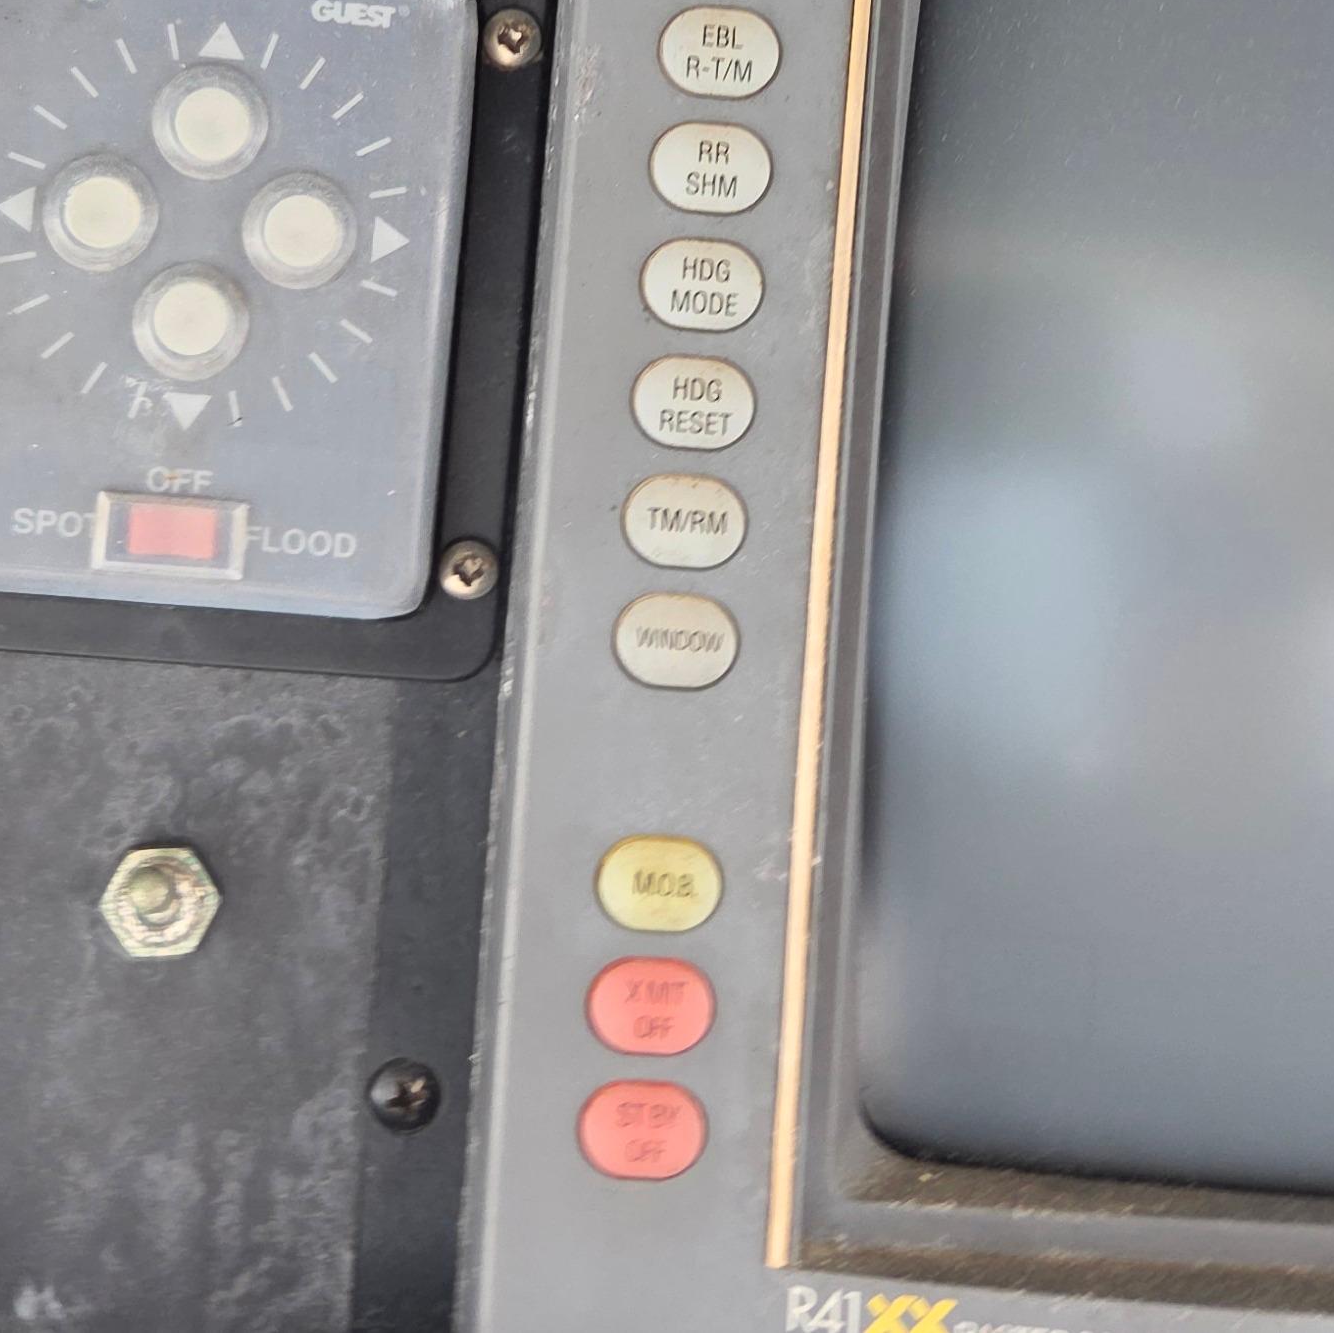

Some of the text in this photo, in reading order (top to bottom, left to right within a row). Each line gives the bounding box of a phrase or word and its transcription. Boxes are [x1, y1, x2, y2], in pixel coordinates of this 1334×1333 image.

[311, 0, 395, 29] GUEST
[702, 24, 743, 50] EBL
[686, 55, 752, 83] R-T/M
[697, 139, 730, 165] RR
[685, 171, 737, 198] SHM
[681, 256, 730, 283] HDG
[670, 289, 738, 316] MODE
[672, 376, 723, 403] HDG
[658, 408, 733, 436] RESET
[145, 466, 214, 493] OFF
[647, 506, 729, 536] TM/RM
[245, 526, 357, 559] FLOOD
[635, 626, 725, 652] WINDOW
